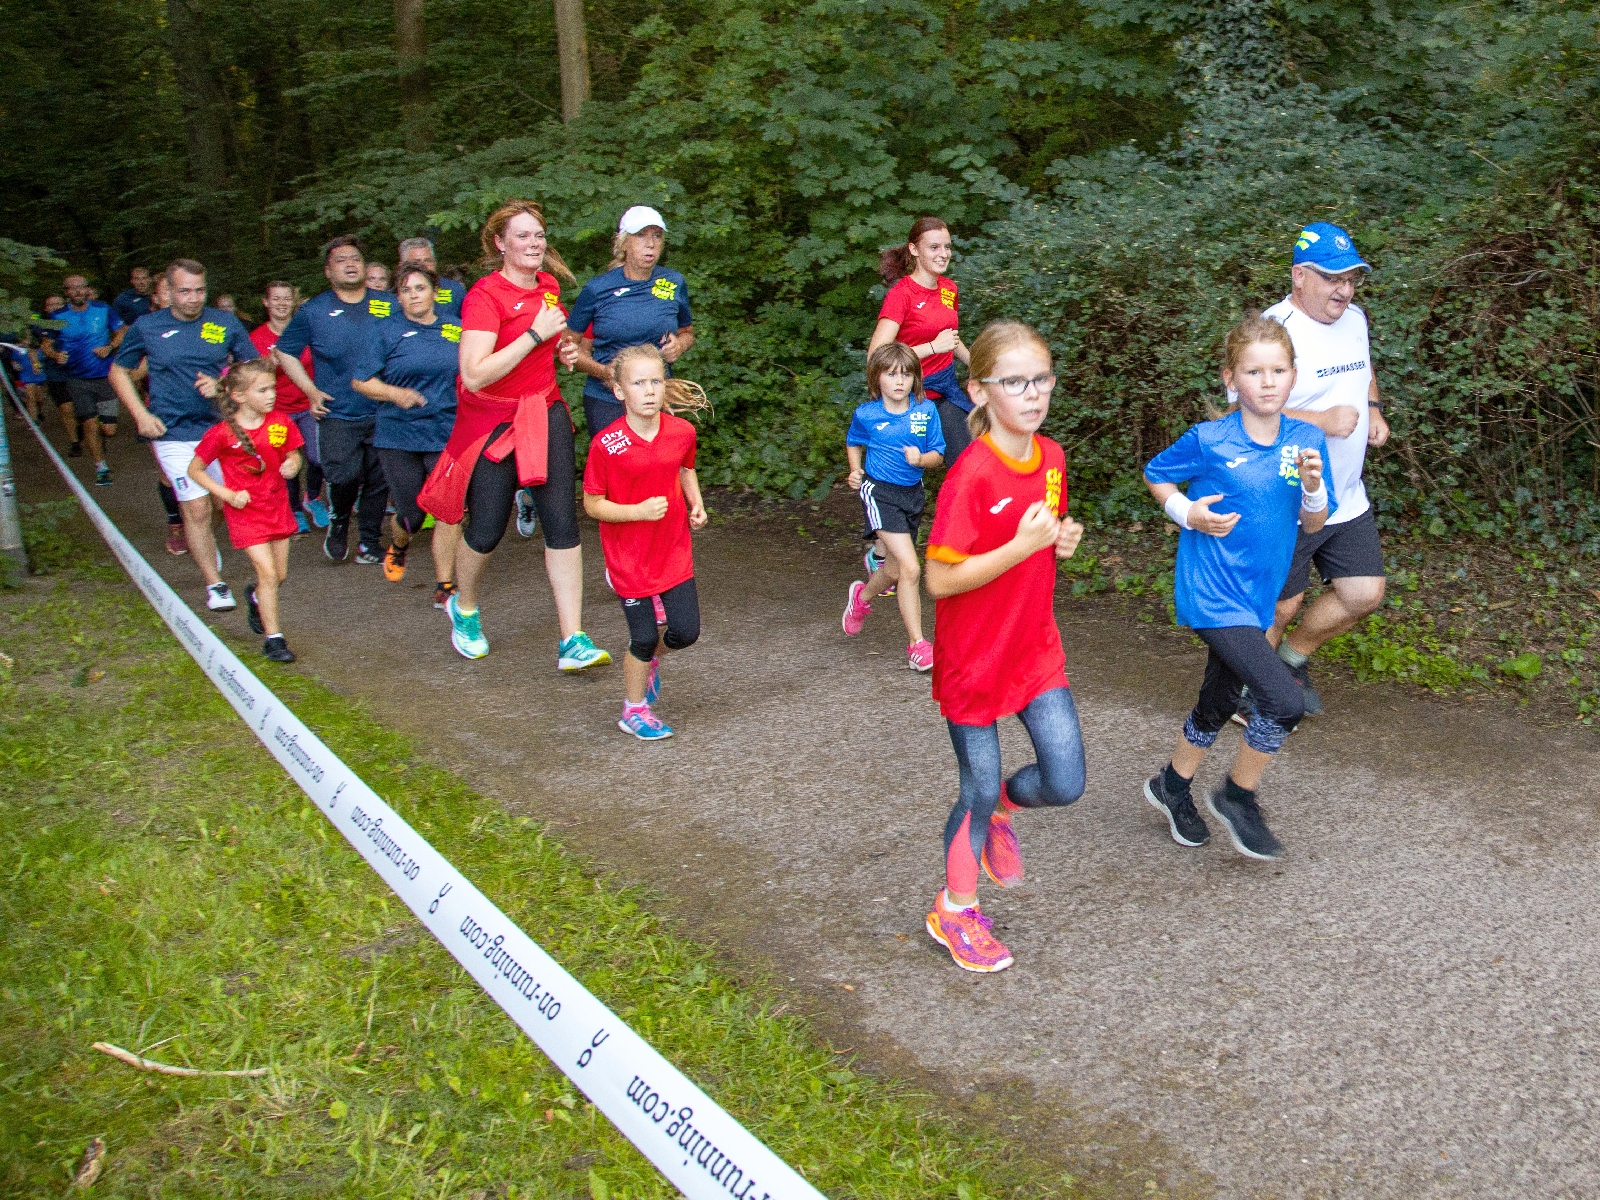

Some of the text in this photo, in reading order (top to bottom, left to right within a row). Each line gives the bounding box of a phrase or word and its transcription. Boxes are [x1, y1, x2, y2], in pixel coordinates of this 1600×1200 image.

[1281, 444, 1300, 458] ci
[350, 806, 420, 881] on-running.com
[459, 915, 561, 1020] on-running.com
[626, 1074, 770, 1200] -running.com
